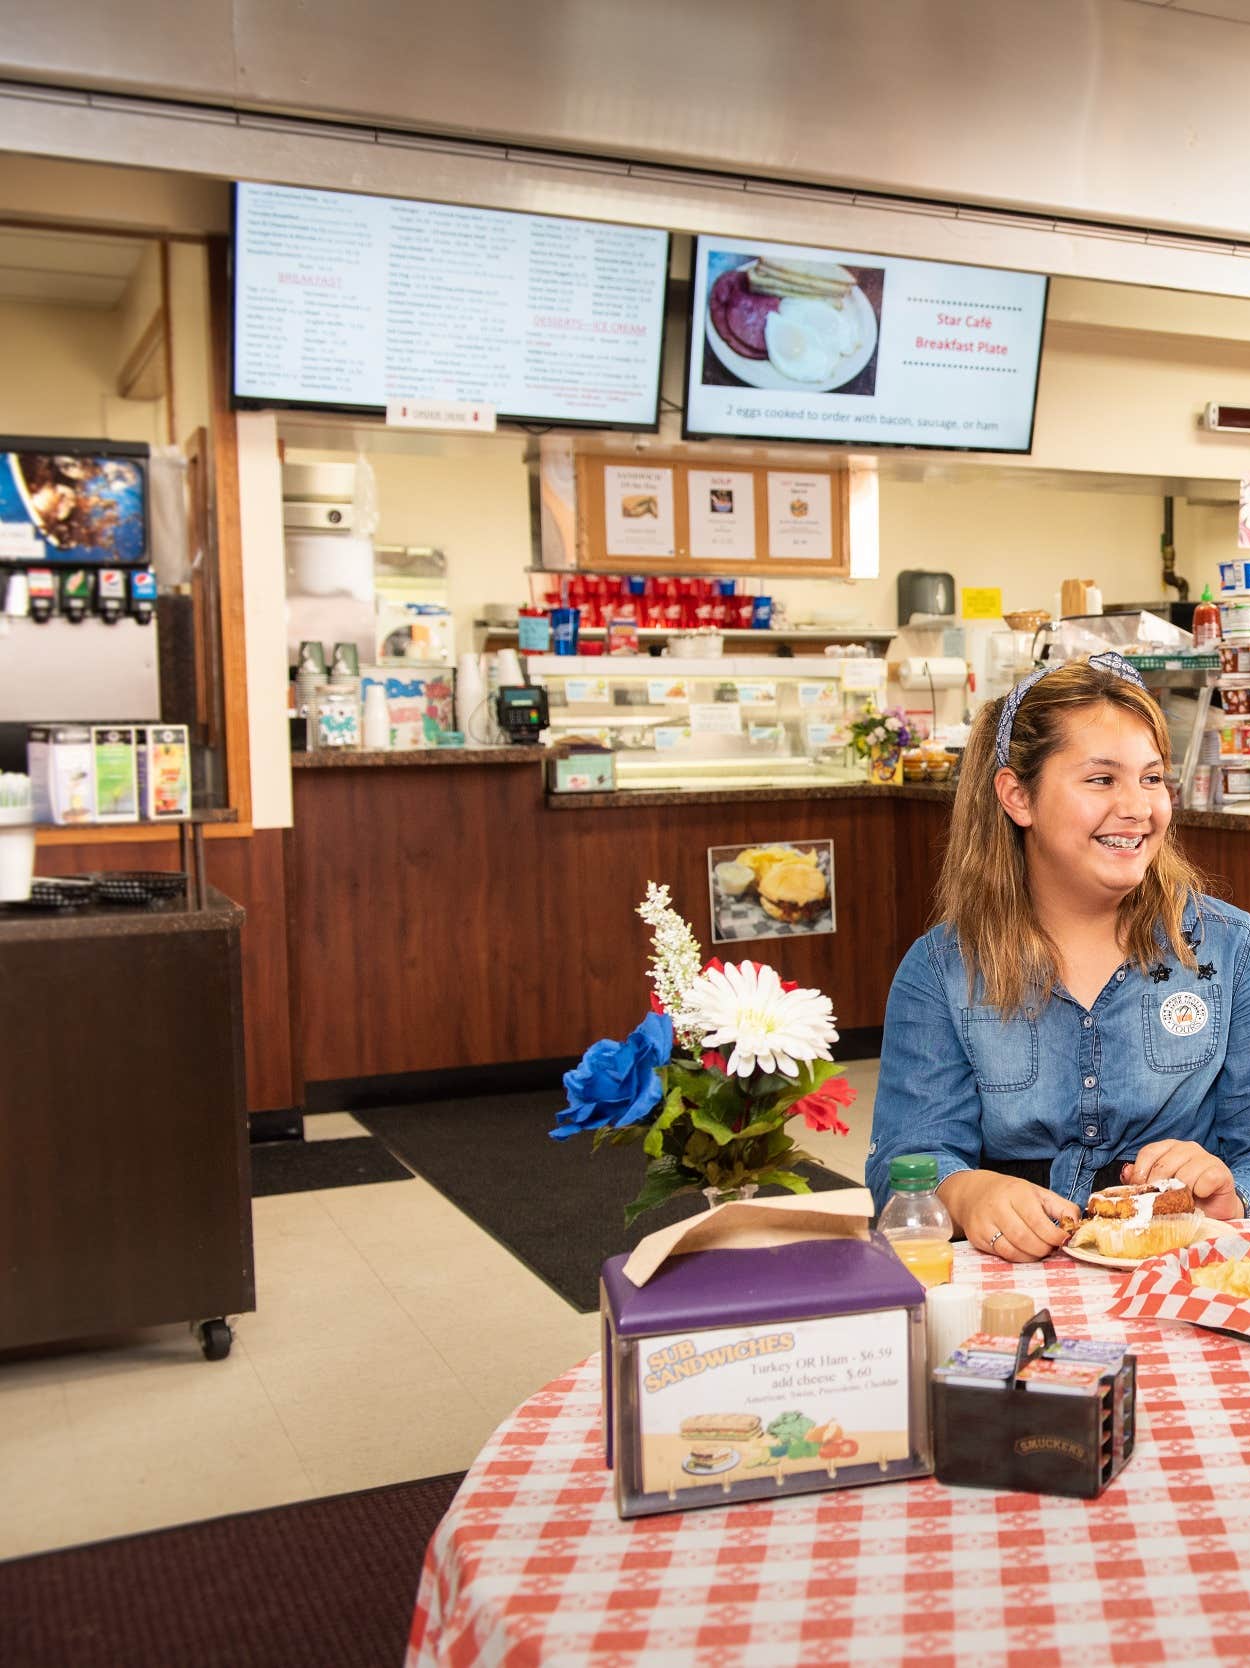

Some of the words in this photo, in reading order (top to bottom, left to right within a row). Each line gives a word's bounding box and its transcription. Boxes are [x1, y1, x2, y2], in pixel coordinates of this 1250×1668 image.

[937, 312, 961, 326] Star
[965, 315, 992, 328] Café
[915, 335, 974, 352] Breakfast
[977, 341, 1008, 355] Plate
[725, 404, 733, 416] 2
[736, 407, 761, 419] eggs
[764, 406, 804, 420] cooked
[807, 409, 819, 420] to
[821, 411, 850, 423] order
[853, 412, 878, 425] with
[880, 414, 914, 427] bacon,
[962, 421, 974, 430] or
[976, 418, 1000, 432] ham
[644, 1332, 796, 1394] SANDWICHES
[647, 1339, 696, 1373] SUB
[751, 1362, 792, 1375] Turkey
[796, 1356, 816, 1369] OR
[820, 1354, 849, 1367] Ham
[860, 1347, 893, 1361] $6.59
[772, 1376, 793, 1389] add
[797, 1373, 837, 1386] cheese
[846, 1366, 872, 1380] $.60
